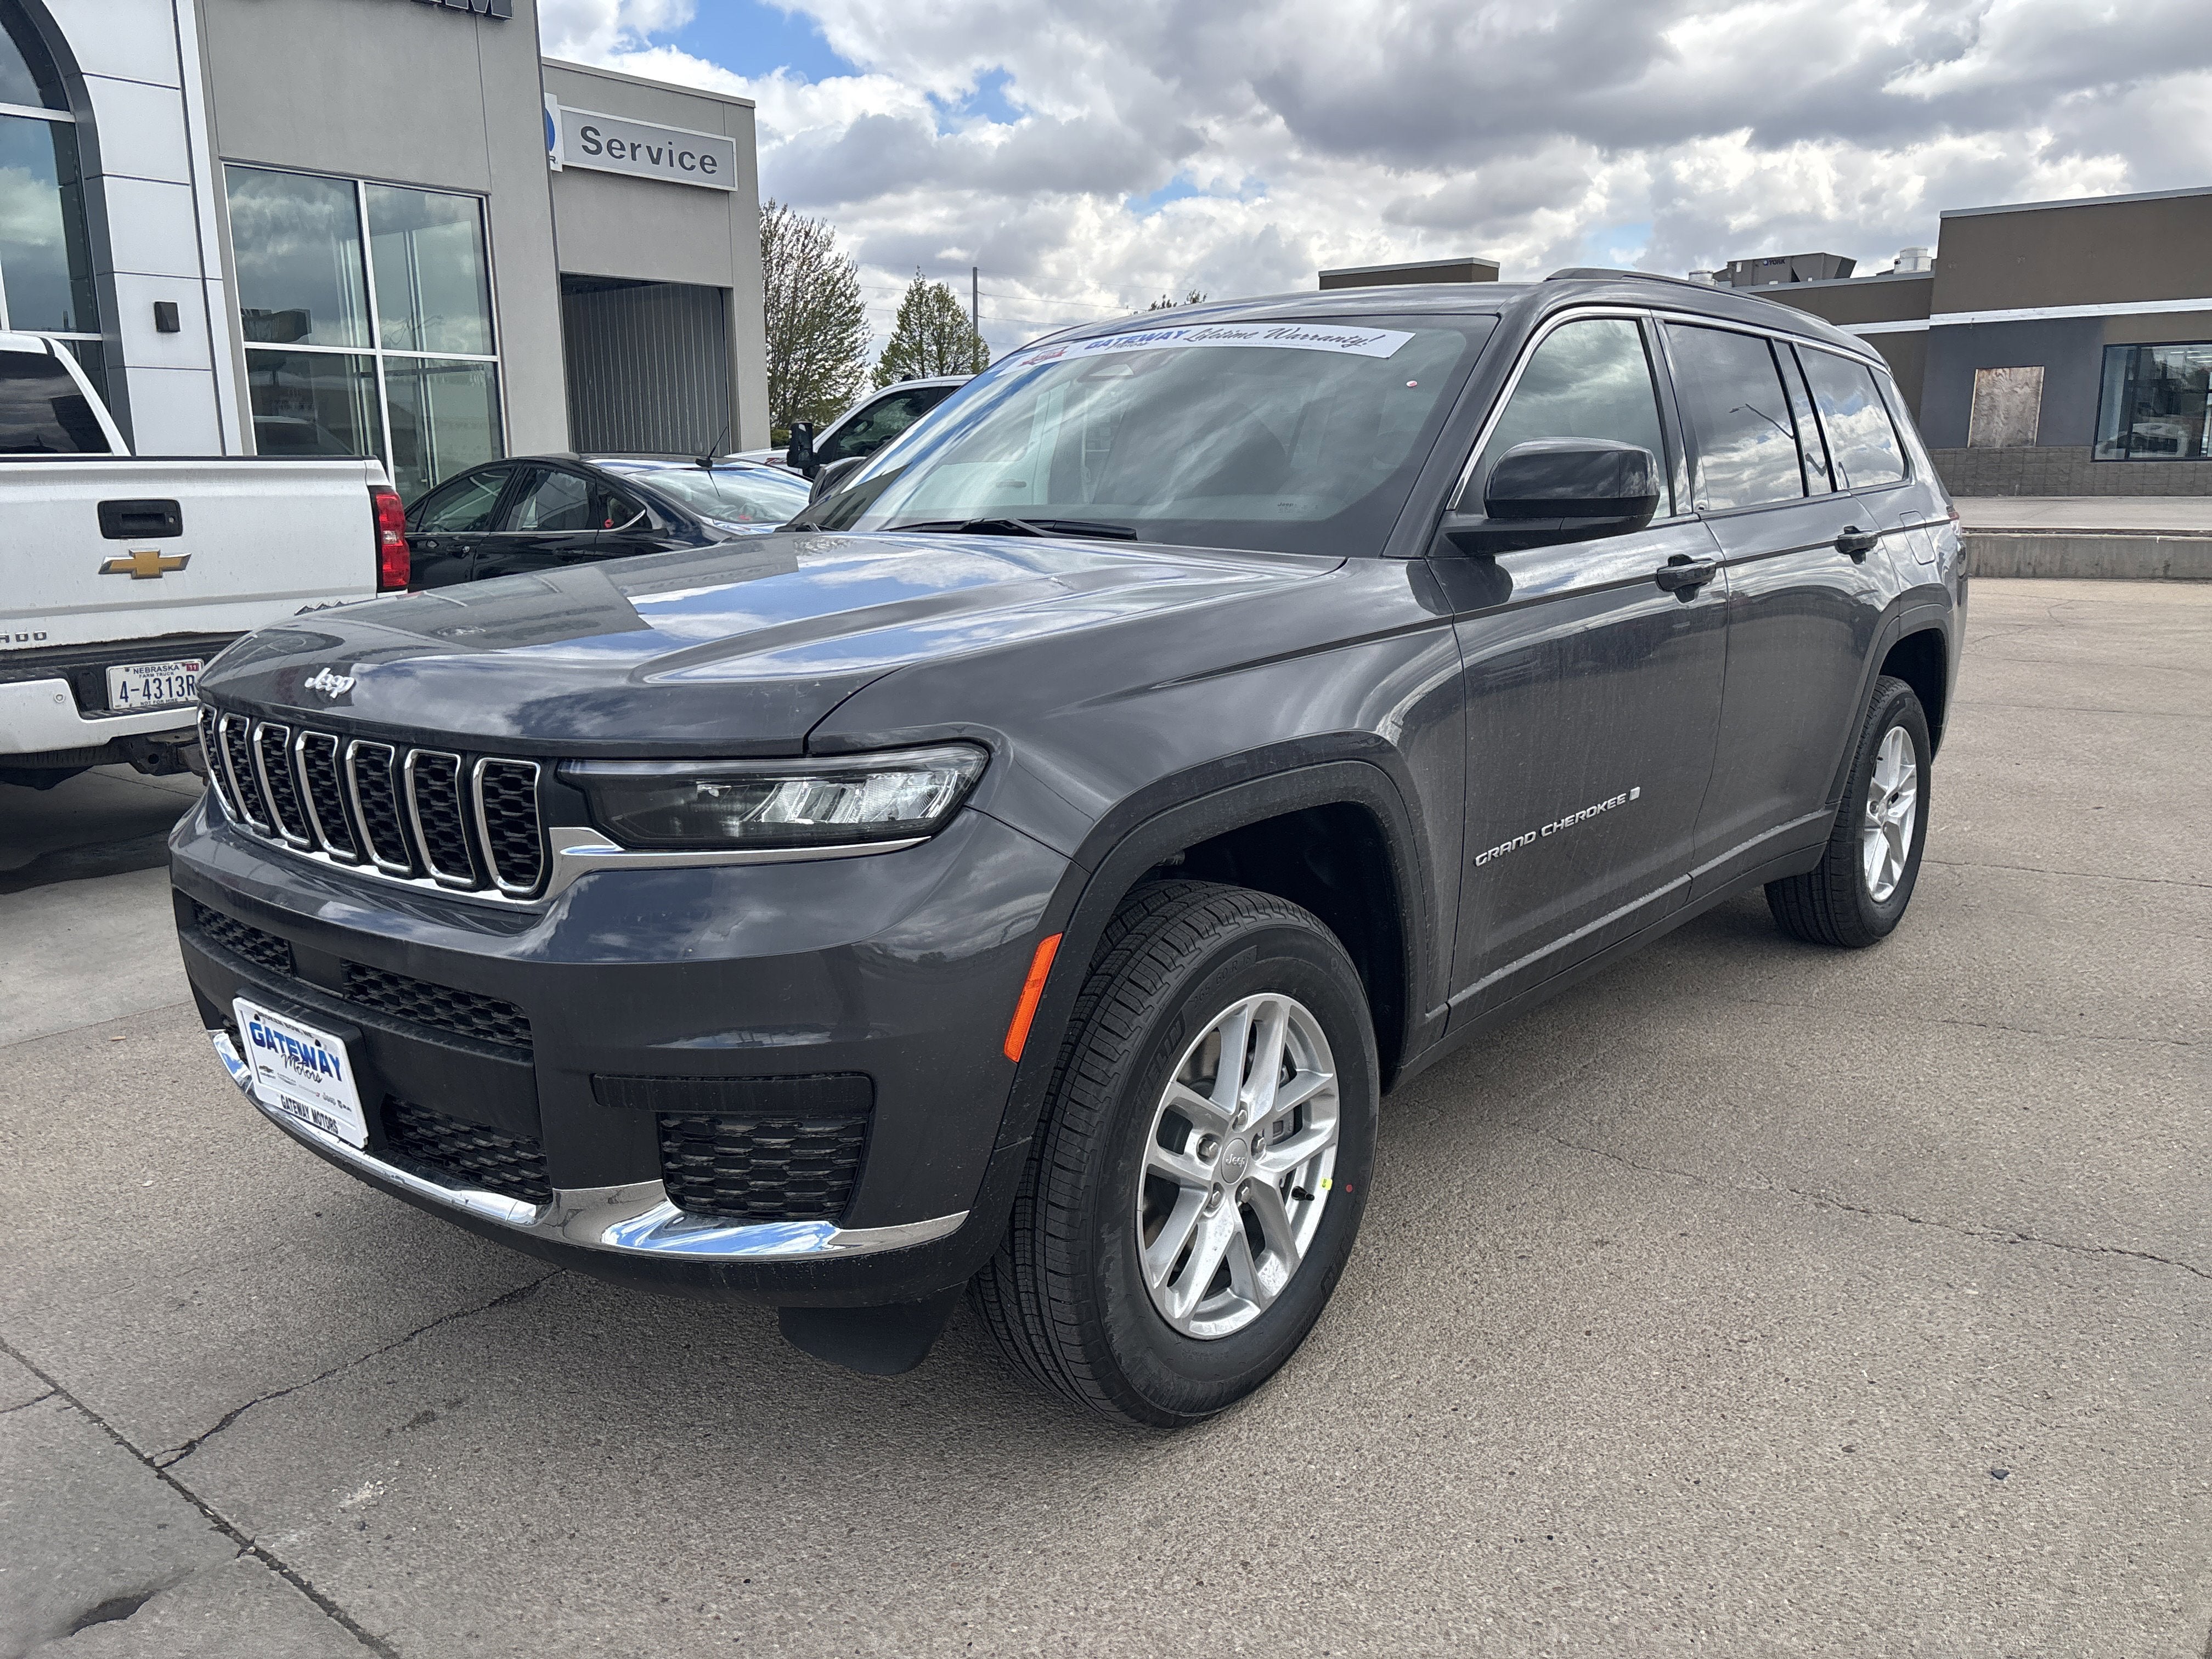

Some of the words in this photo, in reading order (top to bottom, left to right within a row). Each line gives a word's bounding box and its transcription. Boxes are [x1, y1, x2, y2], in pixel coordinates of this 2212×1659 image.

[580, 126, 718, 174] Service
[1084, 329, 1192, 350] GATEWAY
[1183, 328, 1259, 342] Lifetime
[1263, 327, 1386, 348] Warranty!
[133, 664, 180, 674] NEBRASKA
[304, 667, 356, 699] Jeep
[119, 674, 196, 703] 4-4313R
[1474, 831, 1536, 867] GRAND
[1540, 793, 1627, 838] CHEROKEE
[249, 1021, 343, 1082] GATEWAY
[280, 1053, 323, 1084] Motors
[280, 1094, 310, 1120] GATEWAY
[311, 1105, 339, 1135] MOTORS
[1226, 1153, 1246, 1168] Jeep
